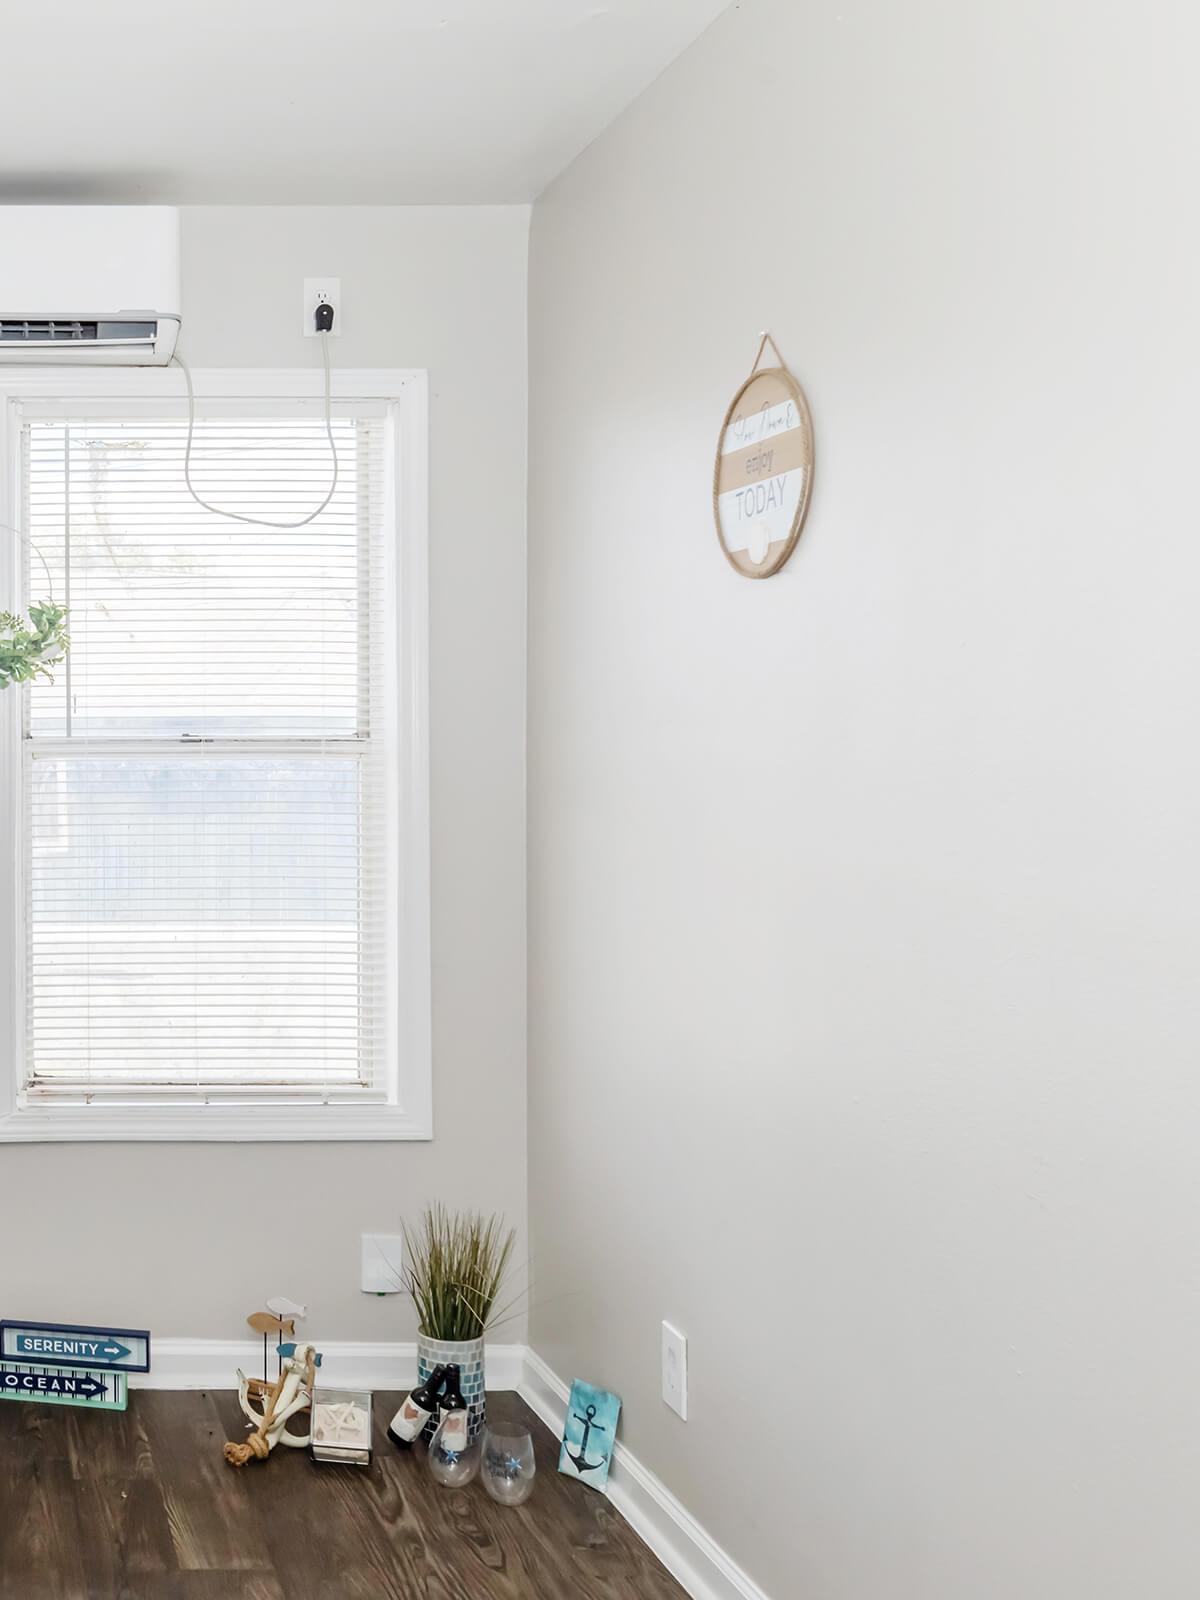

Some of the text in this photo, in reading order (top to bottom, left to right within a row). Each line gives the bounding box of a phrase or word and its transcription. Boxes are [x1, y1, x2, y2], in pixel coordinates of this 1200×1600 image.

[746, 447, 774, 476] enjoy
[735, 474, 787, 521] TODAY
[23, 1338, 99, 1355] SERENITY
[5, 1374, 76, 1391] OCEAN
